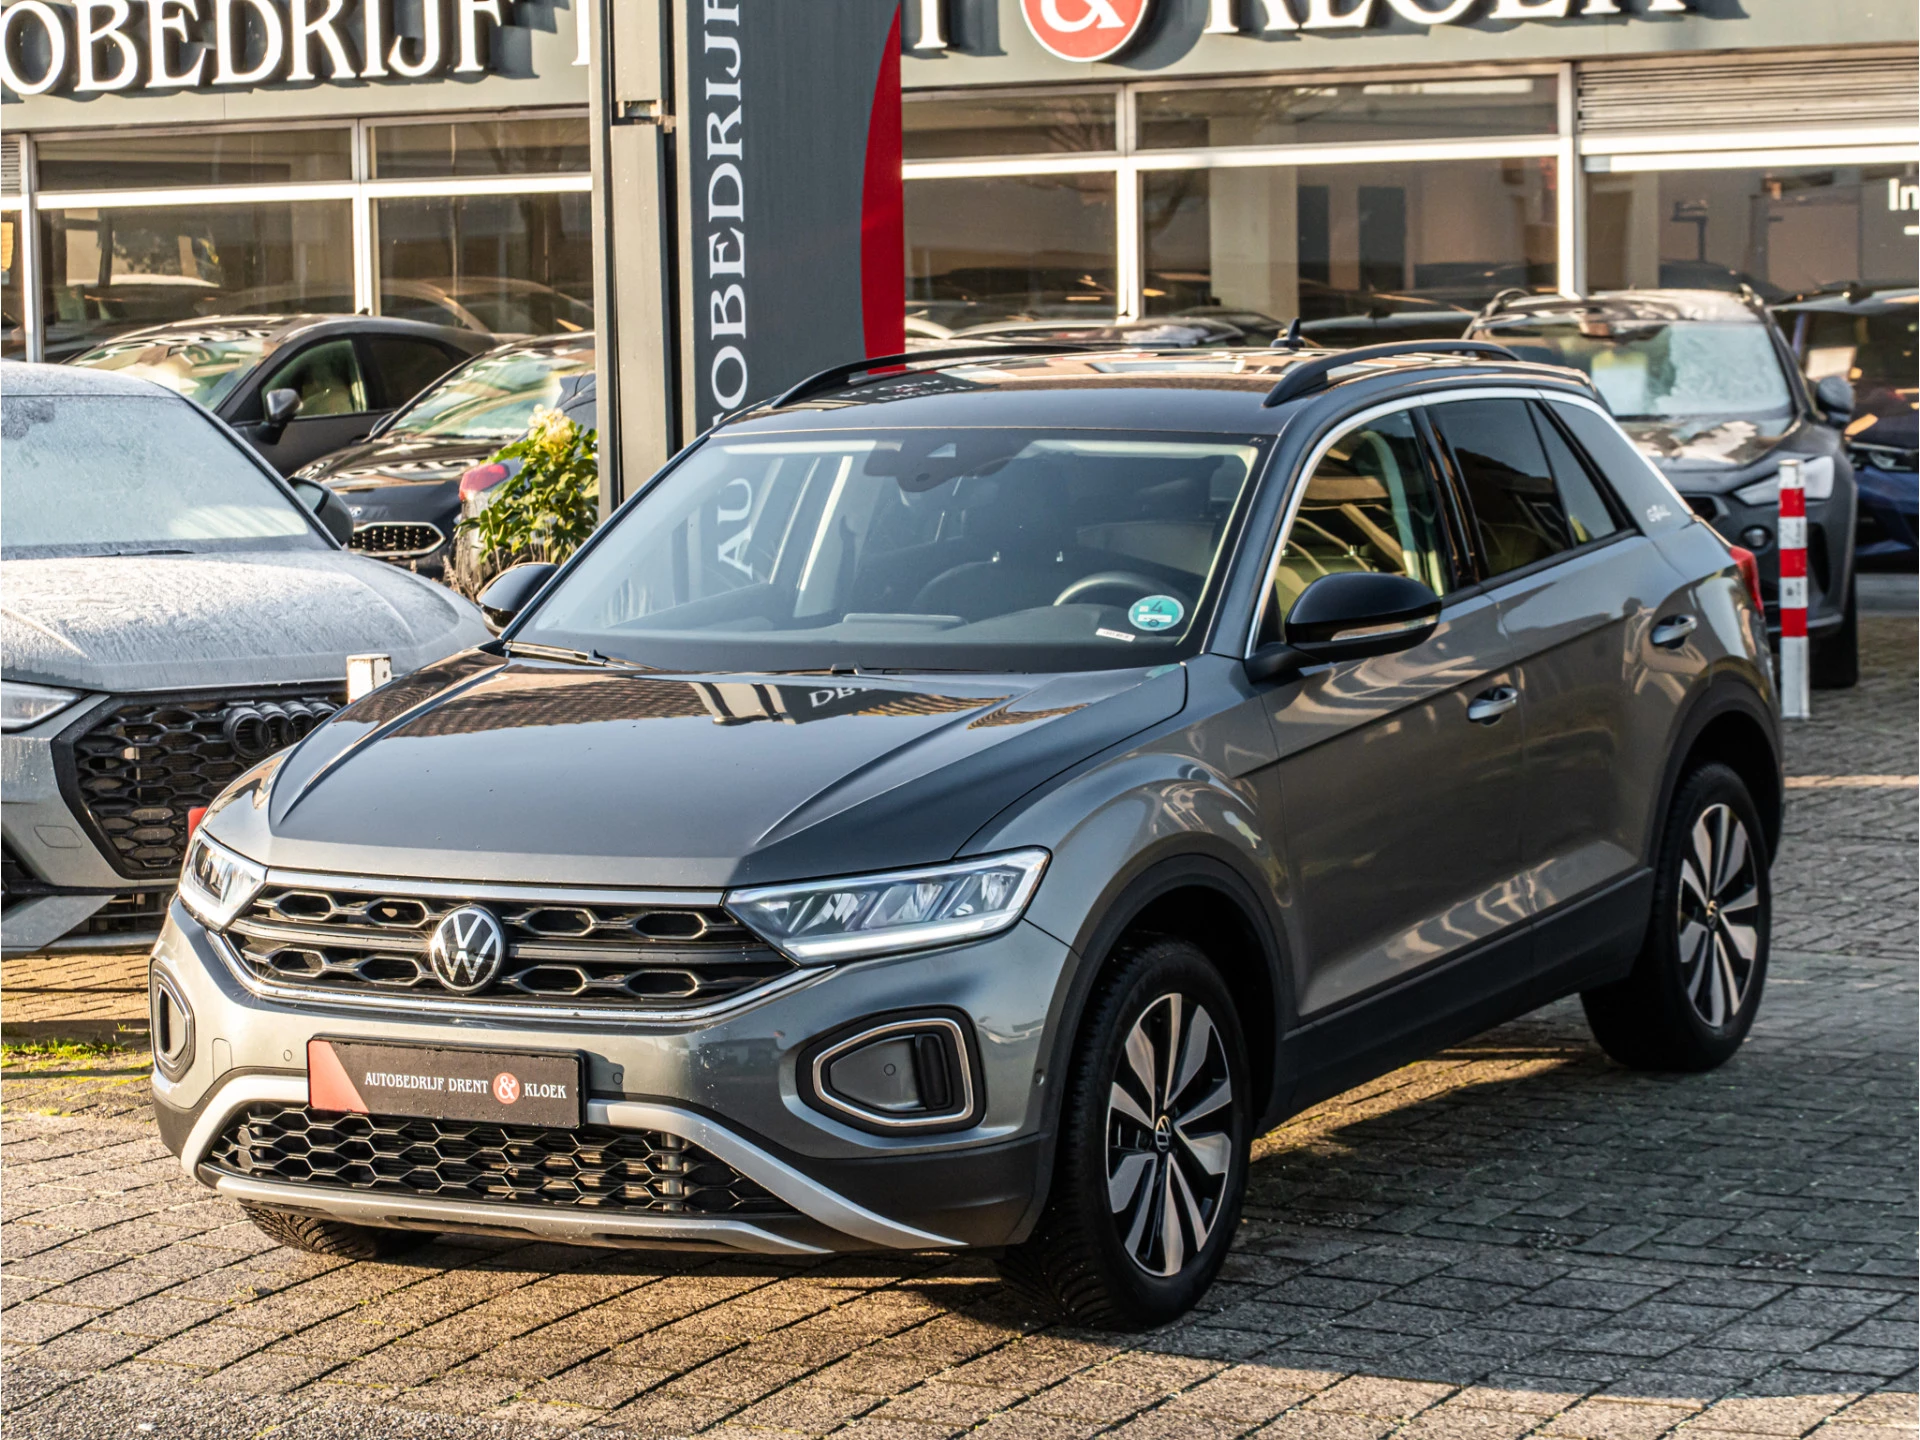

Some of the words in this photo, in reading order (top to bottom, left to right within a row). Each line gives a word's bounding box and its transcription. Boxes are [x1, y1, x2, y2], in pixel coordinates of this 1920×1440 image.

[0, 0, 504, 95] OBEDRIJF
[1150, 600, 1164, 614] 4
[431, 905, 502, 991] VW
[364, 1071, 445, 1091] AUTOBEDRIJF
[448, 1077, 489, 1094] DRENT
[497, 1075, 517, 1100] &
[524, 1082, 568, 1099] KLOEK
